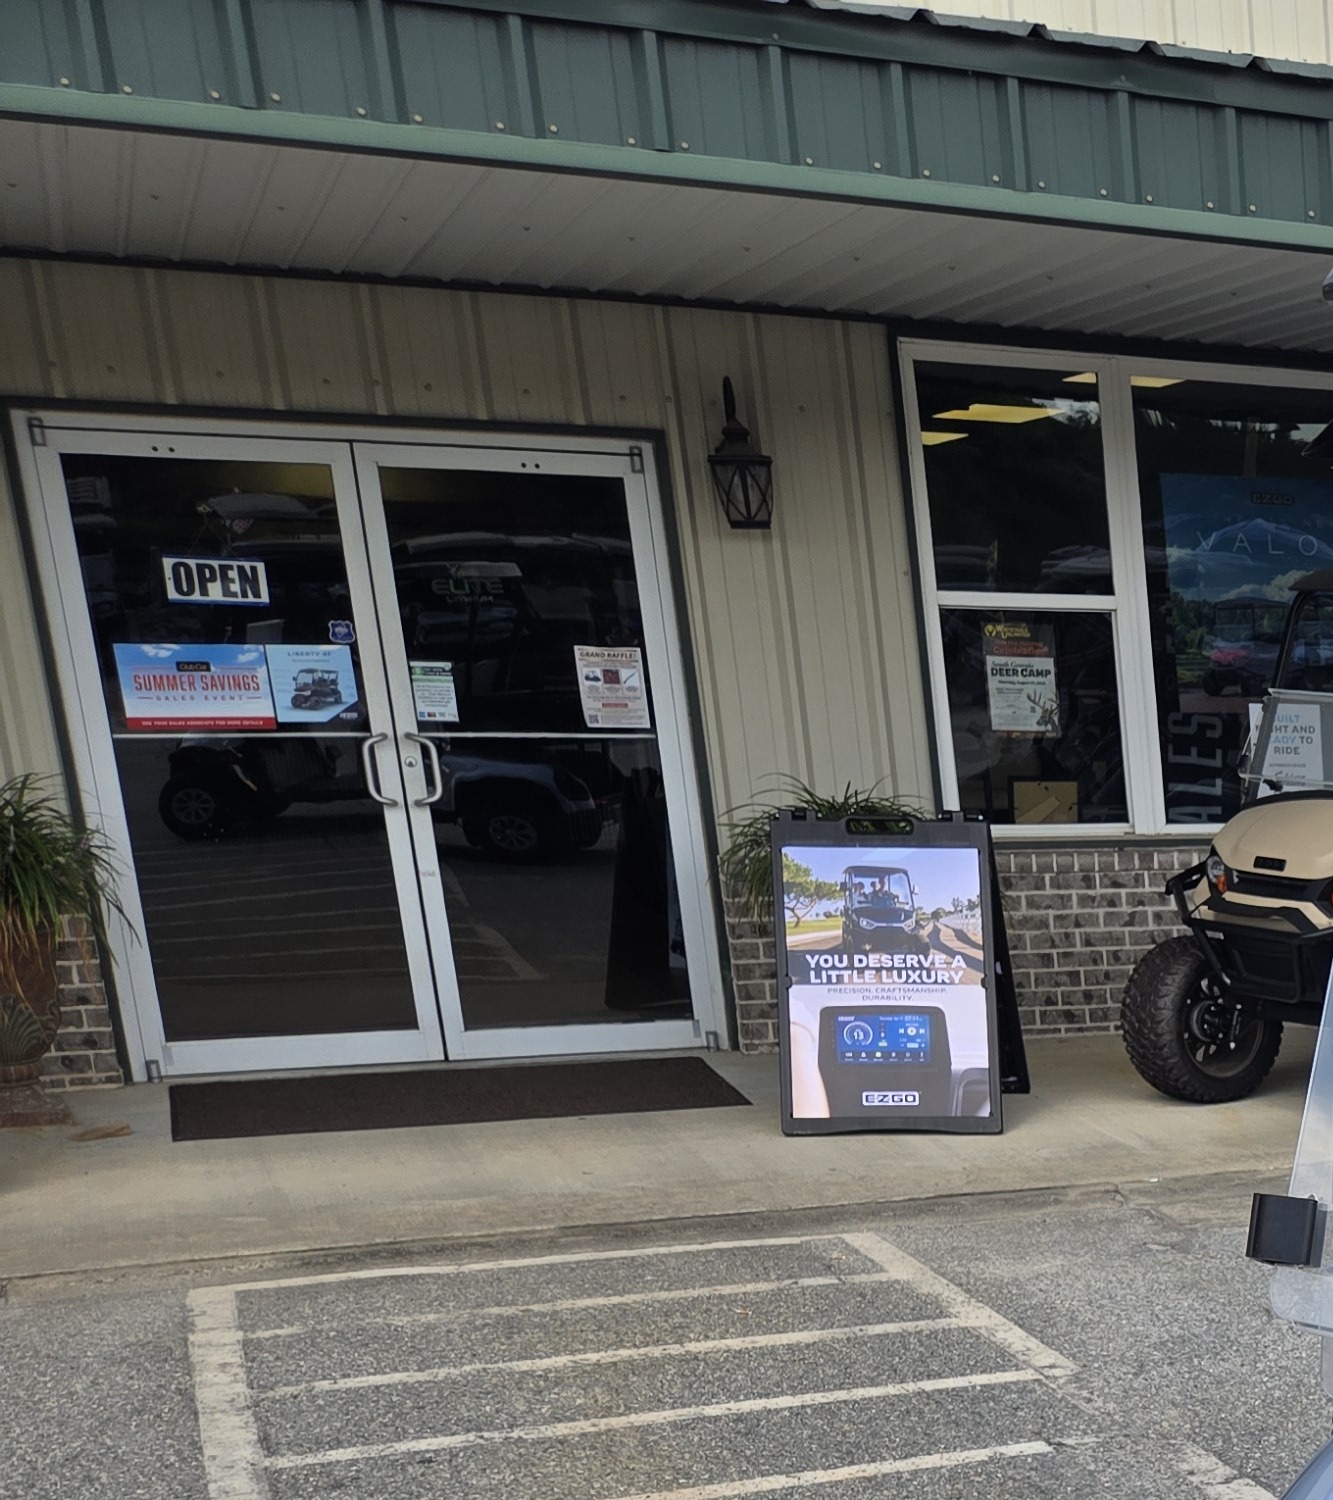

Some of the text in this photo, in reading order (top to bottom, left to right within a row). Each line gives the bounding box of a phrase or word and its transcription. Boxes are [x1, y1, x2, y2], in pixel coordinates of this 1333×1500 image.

[171, 561, 262, 599] OPEN
[431, 578, 504, 594] ELITE
[991, 668, 1052, 679] DEER CAMP
[133, 674, 260, 692] SUMMER SAVINGS
[156, 694, 243, 702] SALES EVENT
[1277, 714, 1301, 723] UILT
[1292, 725, 1316, 734] AND
[1299, 736, 1314, 745] TO
[1273, 747, 1300, 755] RIDE
[805, 953, 967, 969] YOU DESERVE A
[809, 969, 964, 984] LITTLE LUXURY
[865, 1094, 917, 1104] EZGO
